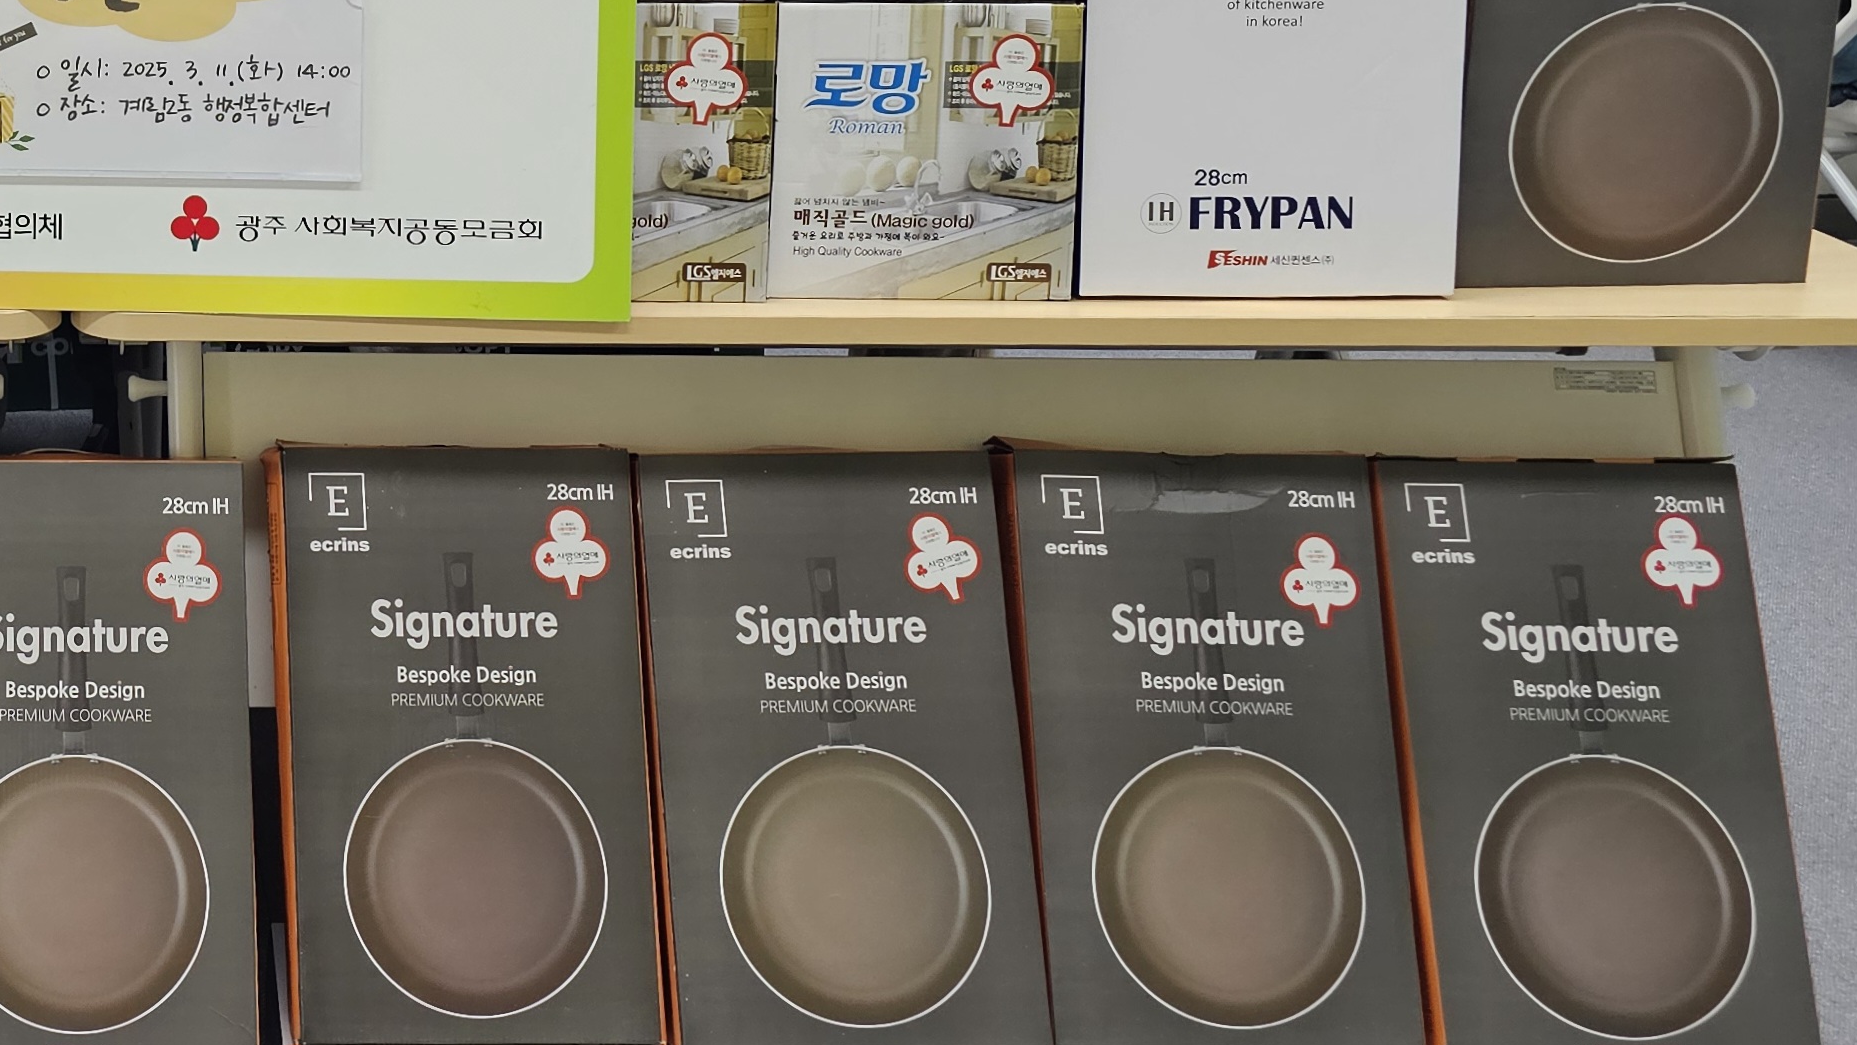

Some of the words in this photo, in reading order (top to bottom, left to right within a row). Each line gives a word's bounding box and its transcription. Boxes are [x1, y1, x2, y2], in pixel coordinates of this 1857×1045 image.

[1246, 16, 1258, 27] in
[1262, 16, 1303, 27] korea!
[60, 56, 109, 92] 일시:
[296, 63, 351, 79] 14:00
[805, 58, 931, 116] 로망
[60, 94, 105, 121] 장소:
[119, 94, 192, 123] 계림2동
[203, 92, 330, 126] 행정복합센터
[828, 117, 907, 136] Roman
[1194, 169, 1248, 186] 28cm
[793, 209, 868, 228] 매직골드
[871, 213, 927, 228] (Magic
[932, 213, 975, 229] gold)
[1148, 201, 1174, 222] IH
[1189, 196, 1353, 230] FRYPAN
[235, 215, 287, 242] 광주
[295, 215, 543, 246] 사회복지공동모금회
[309, 536, 370, 552] ecrins
[669, 543, 732, 559] ecrins
[1044, 539, 1109, 556] ecrins
[1411, 548, 1476, 564] ecrins
[370, 598, 558, 650] Signature
[735, 604, 927, 657] Signature
[1111, 603, 1305, 656] Signature
[1480, 611, 1679, 664] Signature
[396, 664, 472, 687] Bespoke
[476, 665, 537, 687] Design
[764, 670, 841, 693] Bespoke
[845, 670, 908, 692] Design
[1140, 671, 1218, 693] Bespoke
[1222, 673, 1285, 695] Design
[5, 679, 80, 702] Bespoke
[84, 680, 145, 702] Design
[1512, 679, 1592, 701] Bespoke
[1596, 680, 1661, 702] Design
